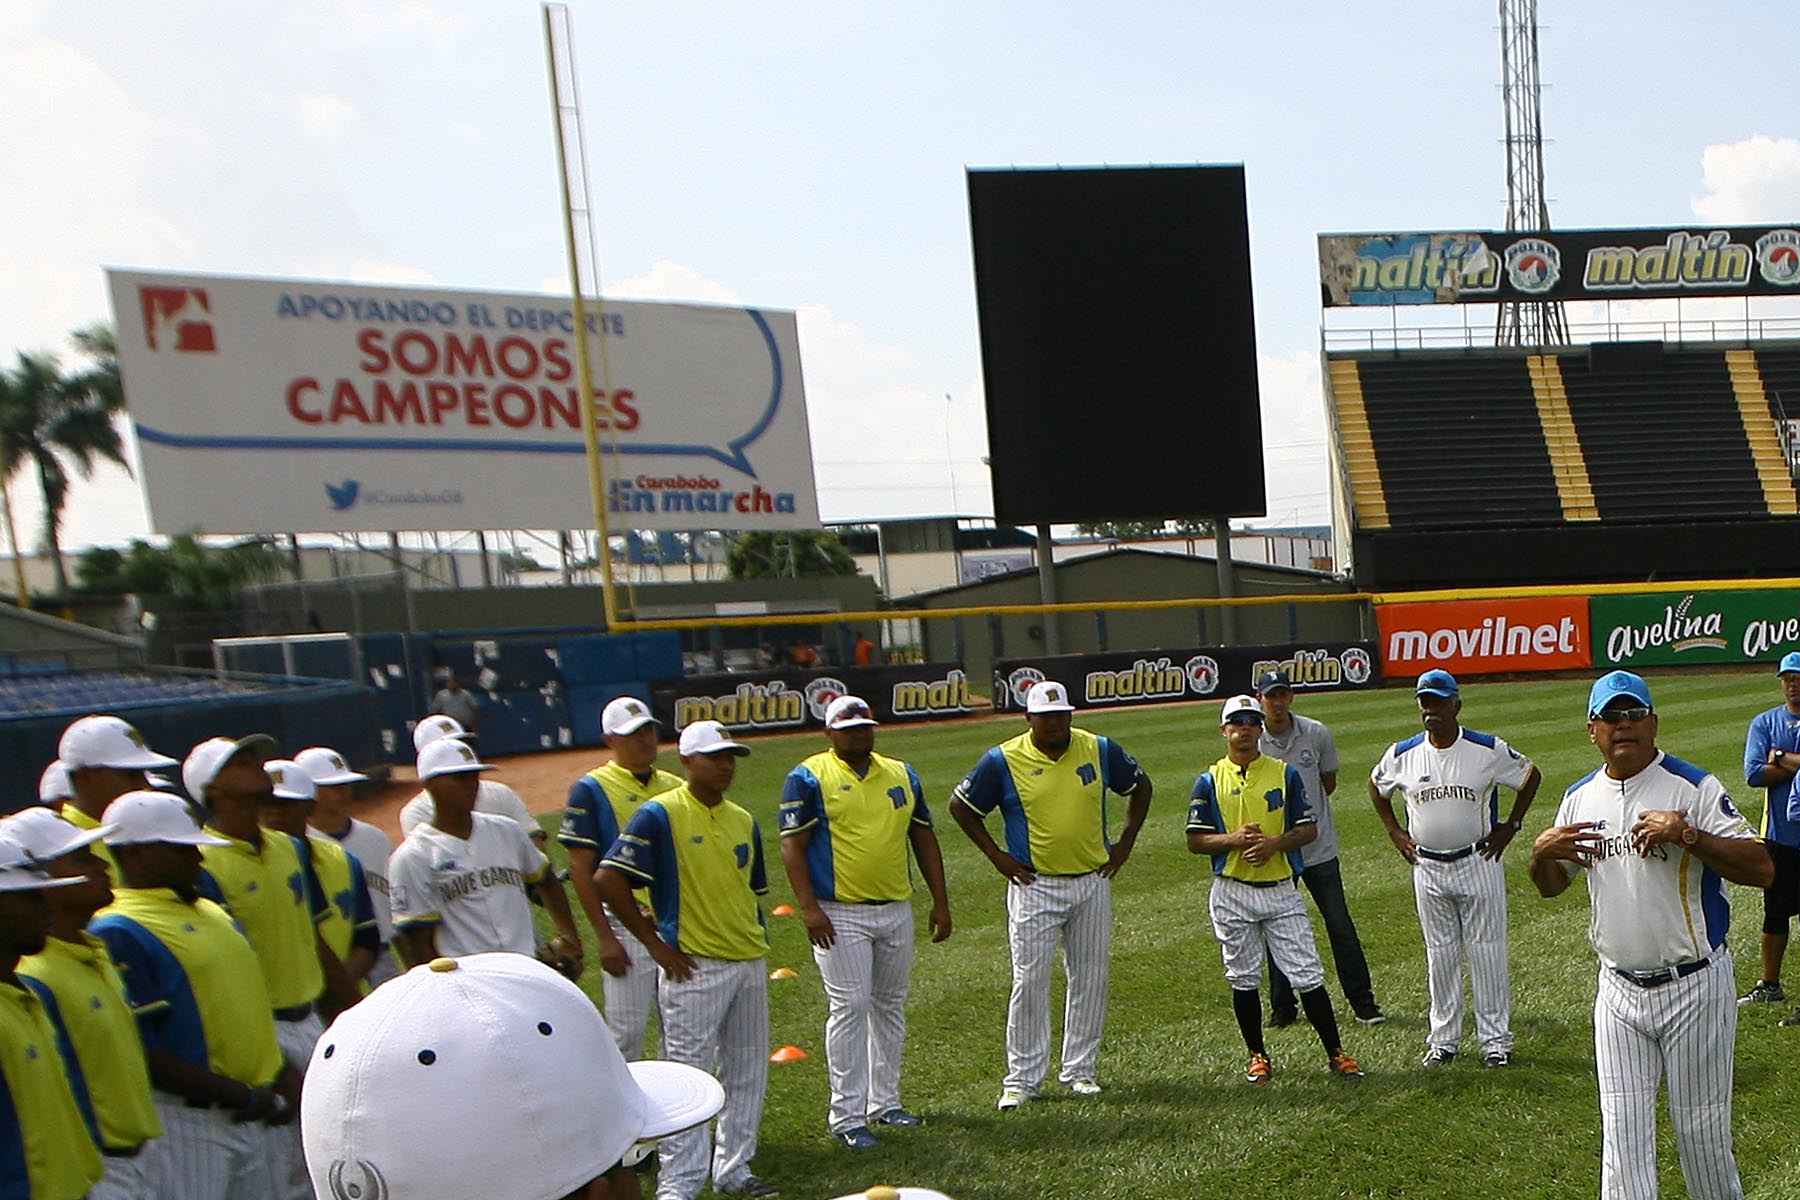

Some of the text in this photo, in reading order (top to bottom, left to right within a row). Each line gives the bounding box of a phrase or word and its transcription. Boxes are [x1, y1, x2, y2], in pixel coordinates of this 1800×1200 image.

[1583, 230, 1752, 289] maltín
[276, 293, 457, 328] APOYANDO
[465, 303, 497, 328] EL
[356, 328, 573, 383] SOMOS
[287, 377, 640, 432] CAMPEONES
[635, 474, 721, 490] Carabobo
[662, 483, 796, 513] marcha
[1389, 617, 1575, 661] movilnet
[1087, 658, 1185, 702] maltín
[676, 681, 804, 731] maltín
